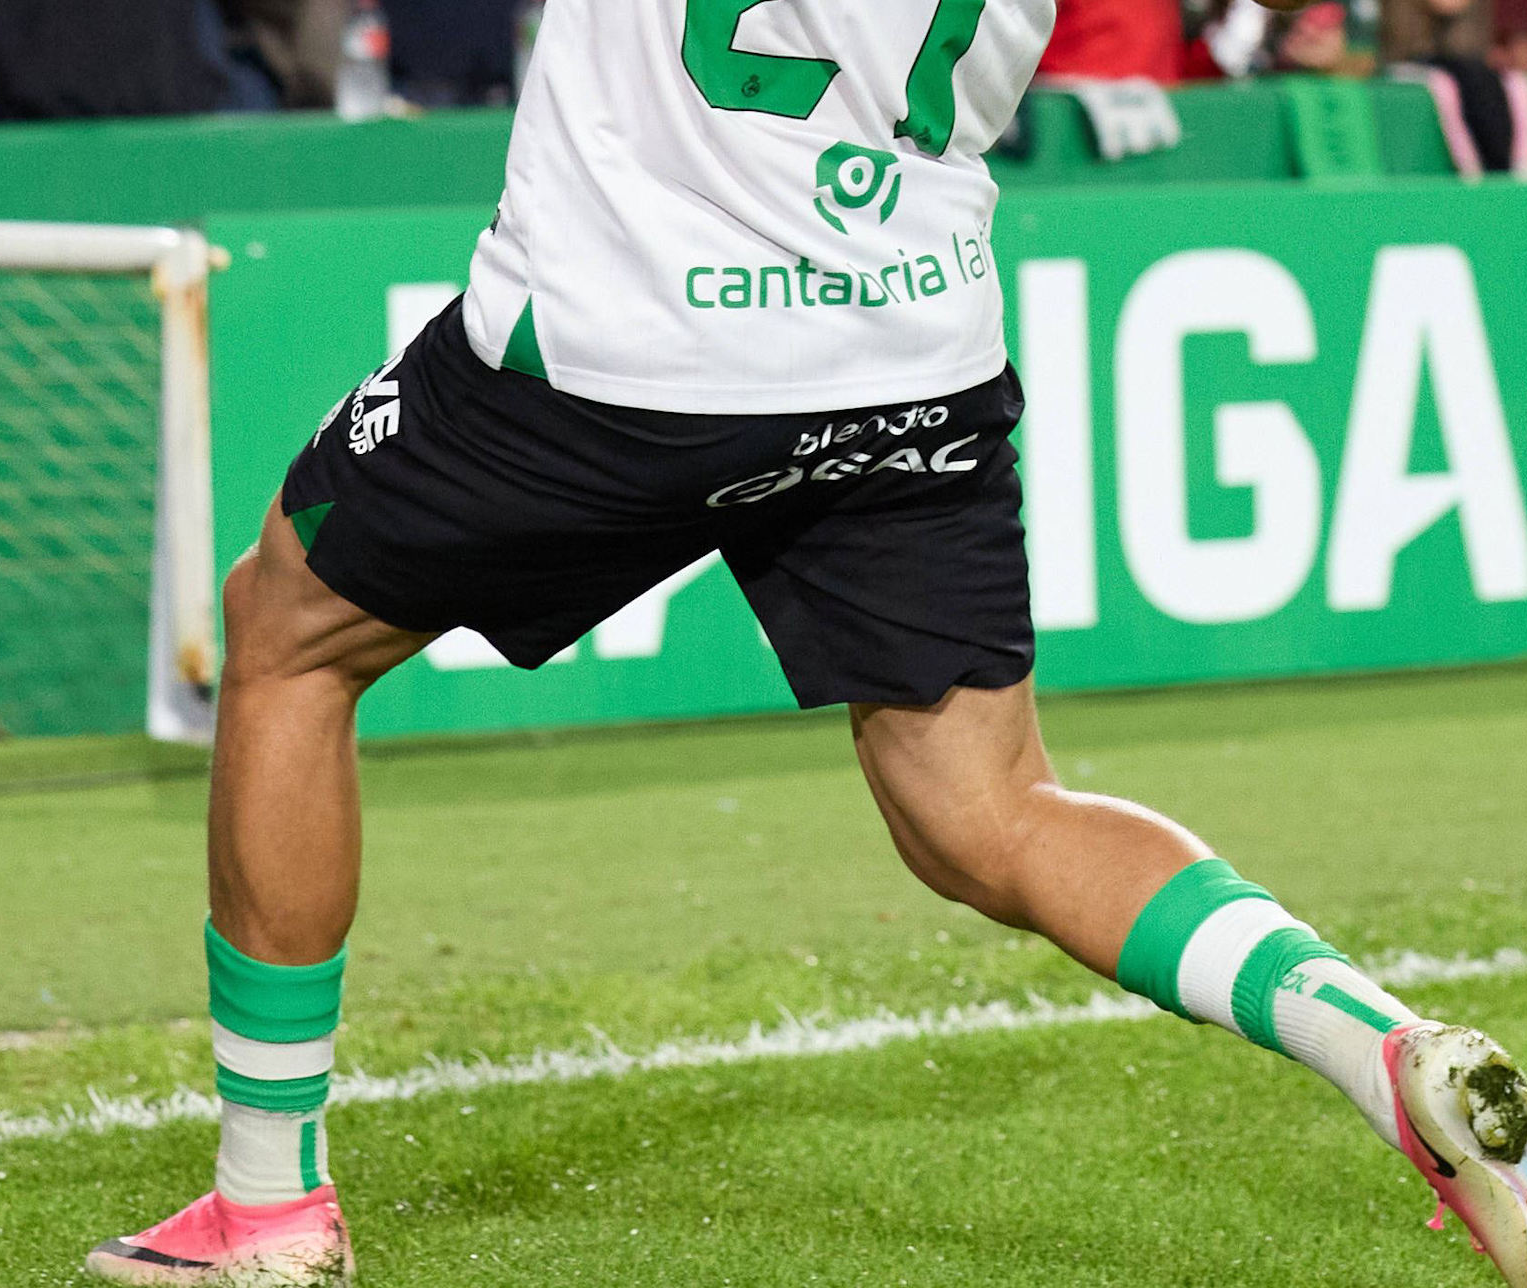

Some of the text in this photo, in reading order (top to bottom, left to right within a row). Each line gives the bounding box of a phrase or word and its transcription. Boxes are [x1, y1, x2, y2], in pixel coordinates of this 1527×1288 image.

[685, 220, 990, 309] cantabria la
[792, 405, 949, 457] blendio
